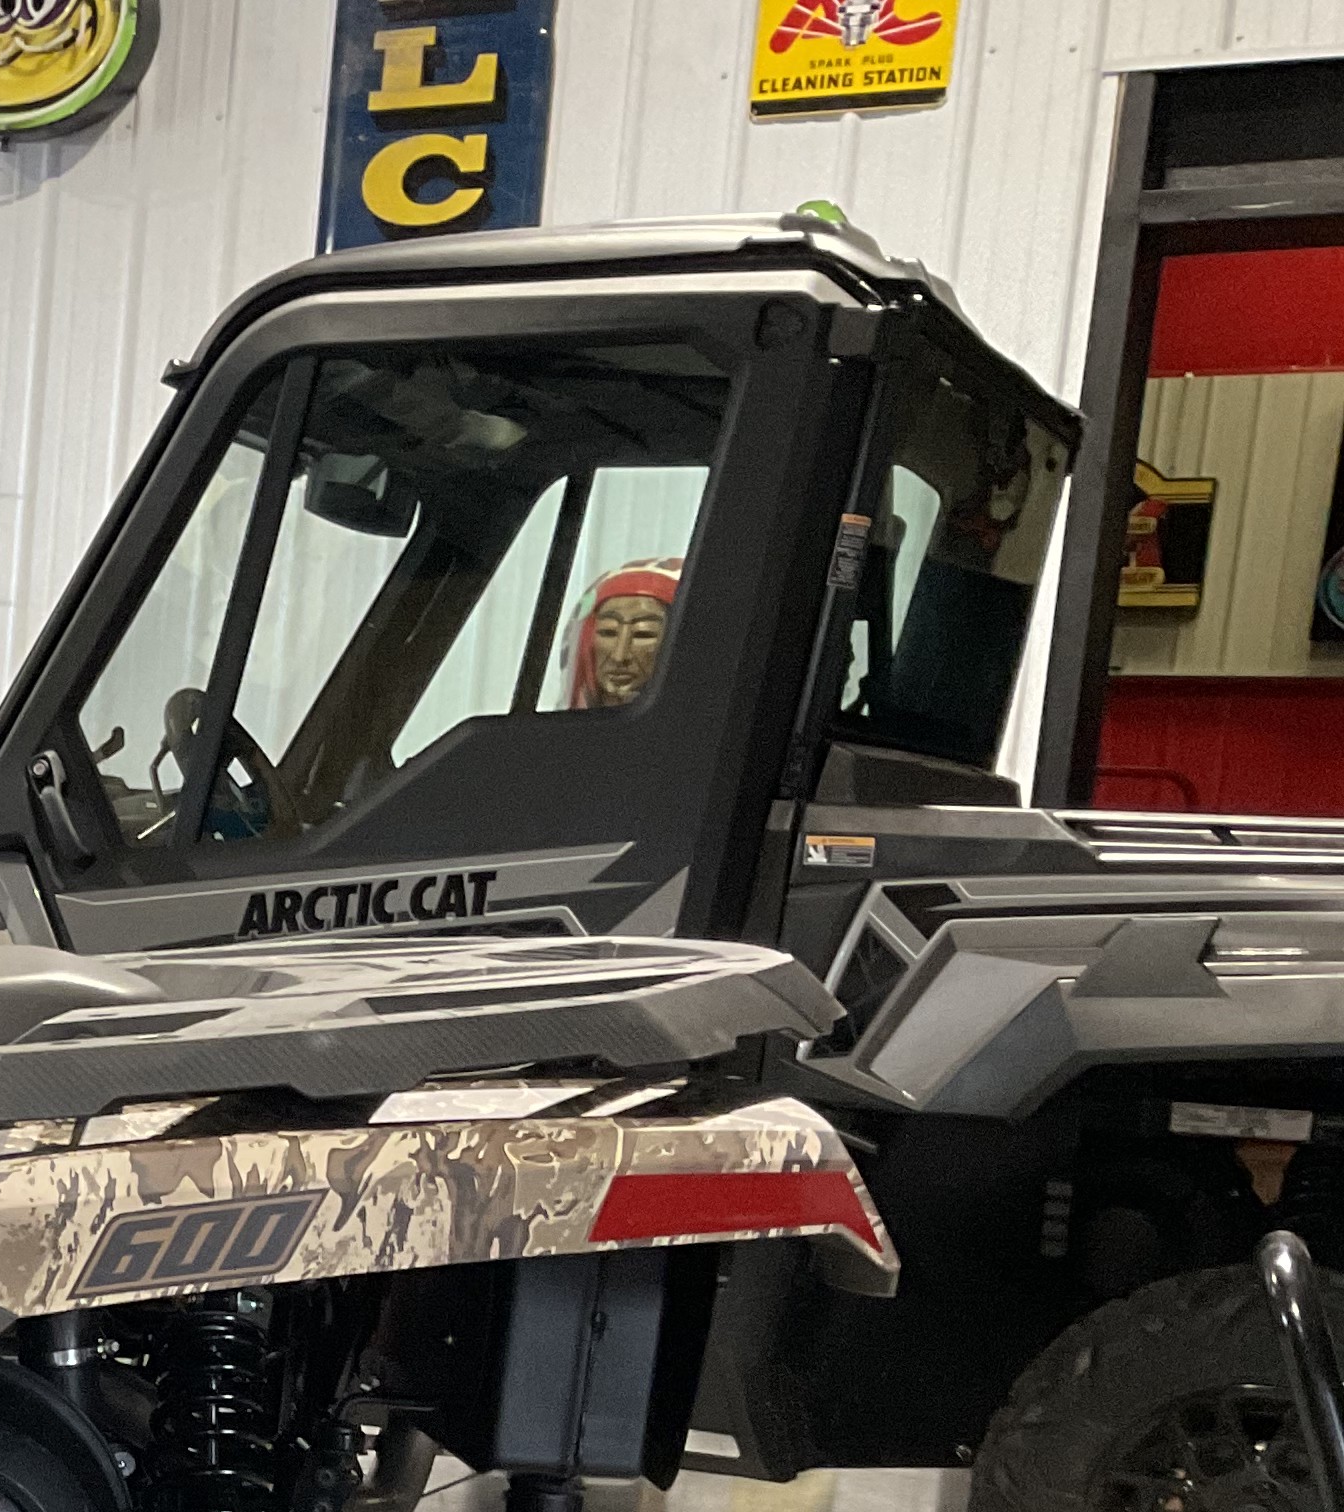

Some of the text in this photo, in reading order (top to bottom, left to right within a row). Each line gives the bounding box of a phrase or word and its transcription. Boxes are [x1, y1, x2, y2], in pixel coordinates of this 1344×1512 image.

[758, 66, 943, 94] CLEANING STATION
[809, 53, 894, 69] SPARK PLUG
[237, 870, 498, 938] ARCTIC CAT
[84, 1199, 313, 1288] 600
